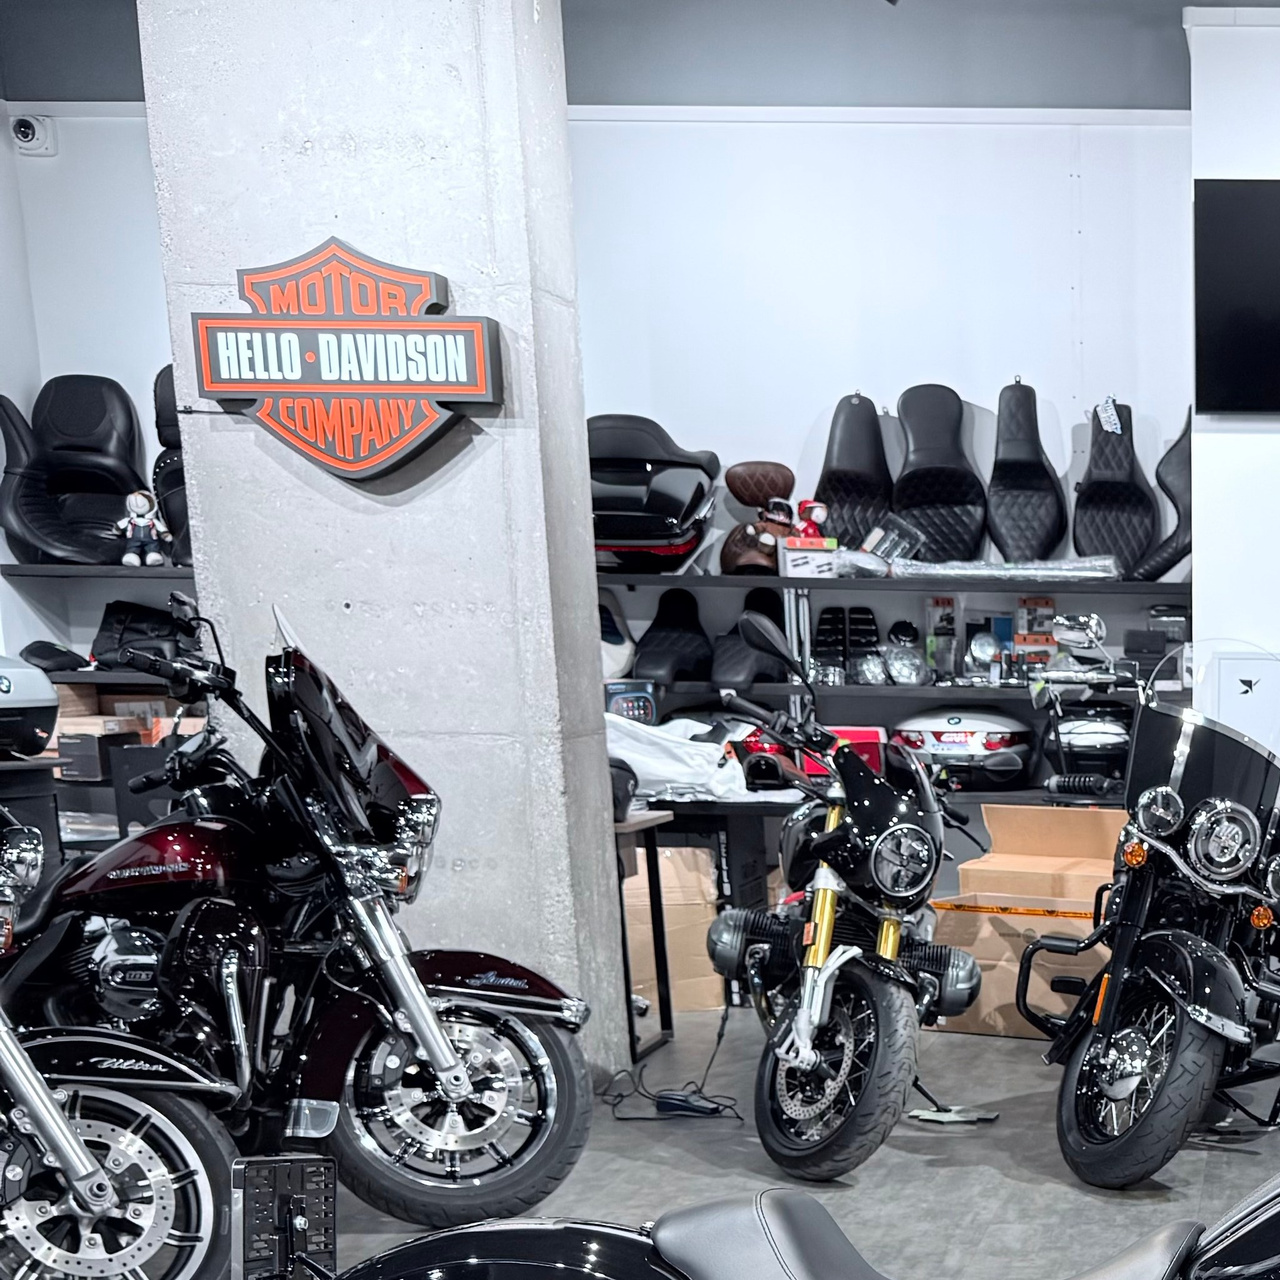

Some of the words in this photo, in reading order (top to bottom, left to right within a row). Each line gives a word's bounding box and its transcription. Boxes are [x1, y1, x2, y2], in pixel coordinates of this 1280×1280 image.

[269, 260, 407, 316] MOTOR
[216, 332, 302, 380] HELLO
[317, 333, 468, 382] DAVIDSON
[278, 397, 416, 459] COMPANY
